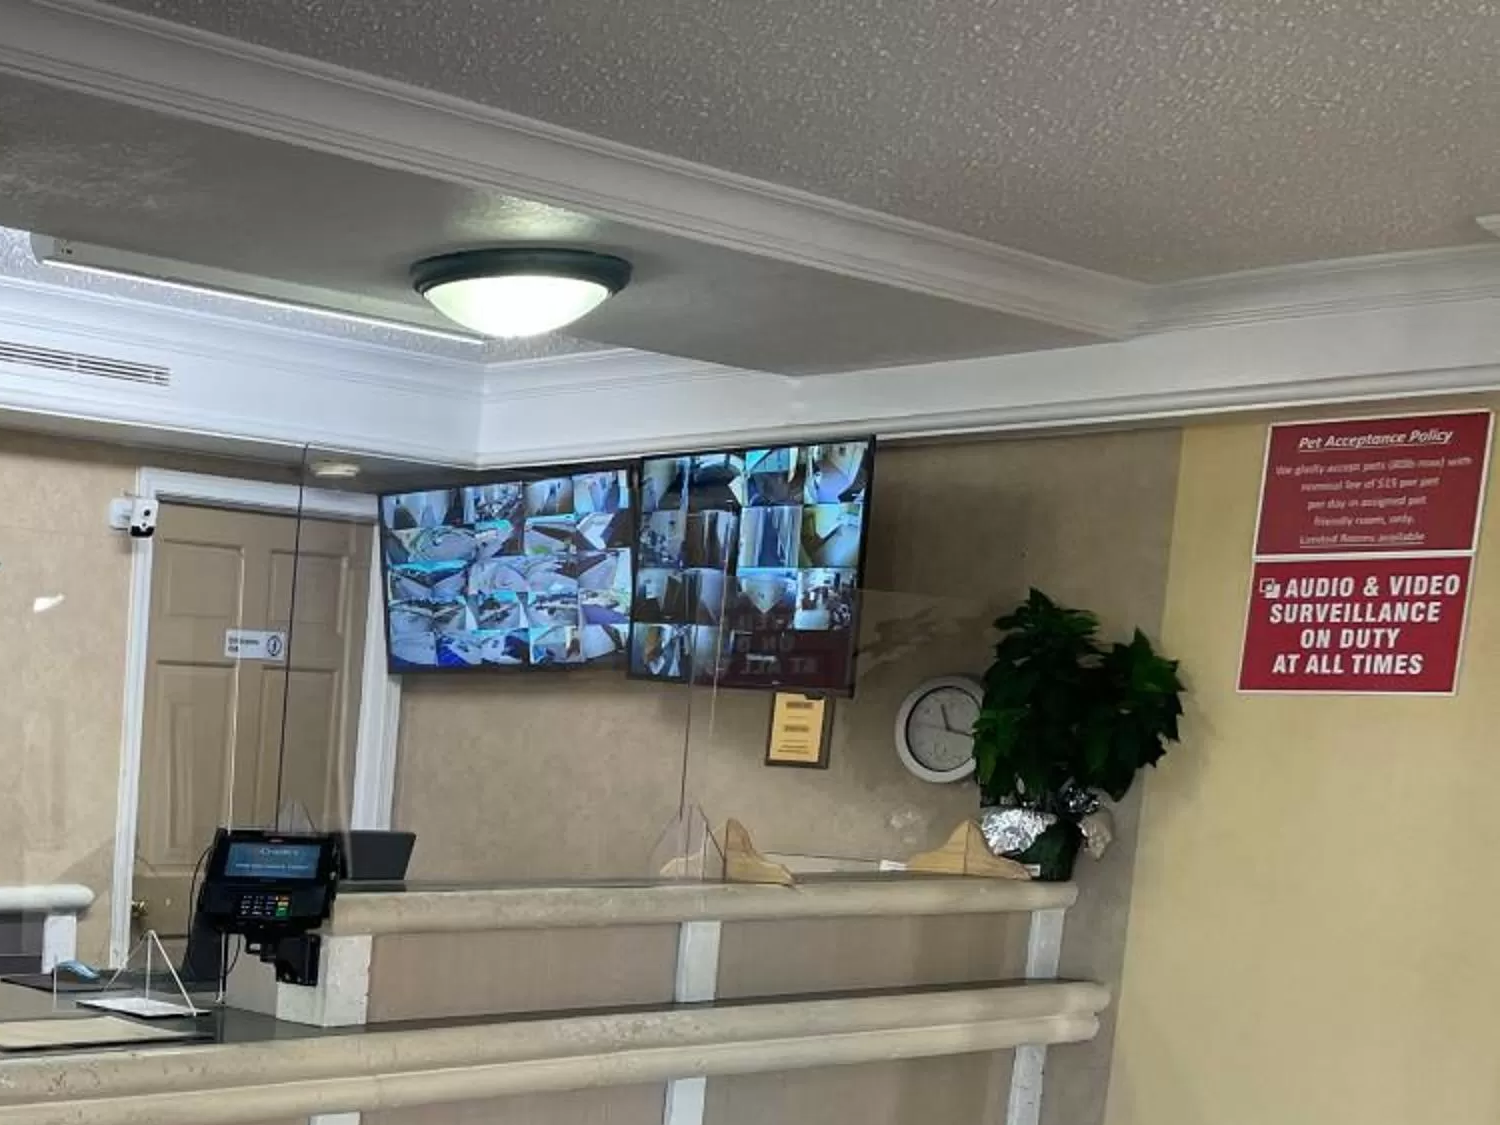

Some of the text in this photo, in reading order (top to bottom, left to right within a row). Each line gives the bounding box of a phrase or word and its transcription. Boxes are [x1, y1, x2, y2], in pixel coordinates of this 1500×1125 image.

[1299, 429, 1453, 449] Pet Acceptance Policy
[1284, 574, 1461, 598] AUDIO & VIDEO
[1269, 602, 1443, 624] SURVEILLANCE
[1300, 628, 1401, 649] ON DUTY
[1272, 653, 1425, 675] AT ALL TIMES
